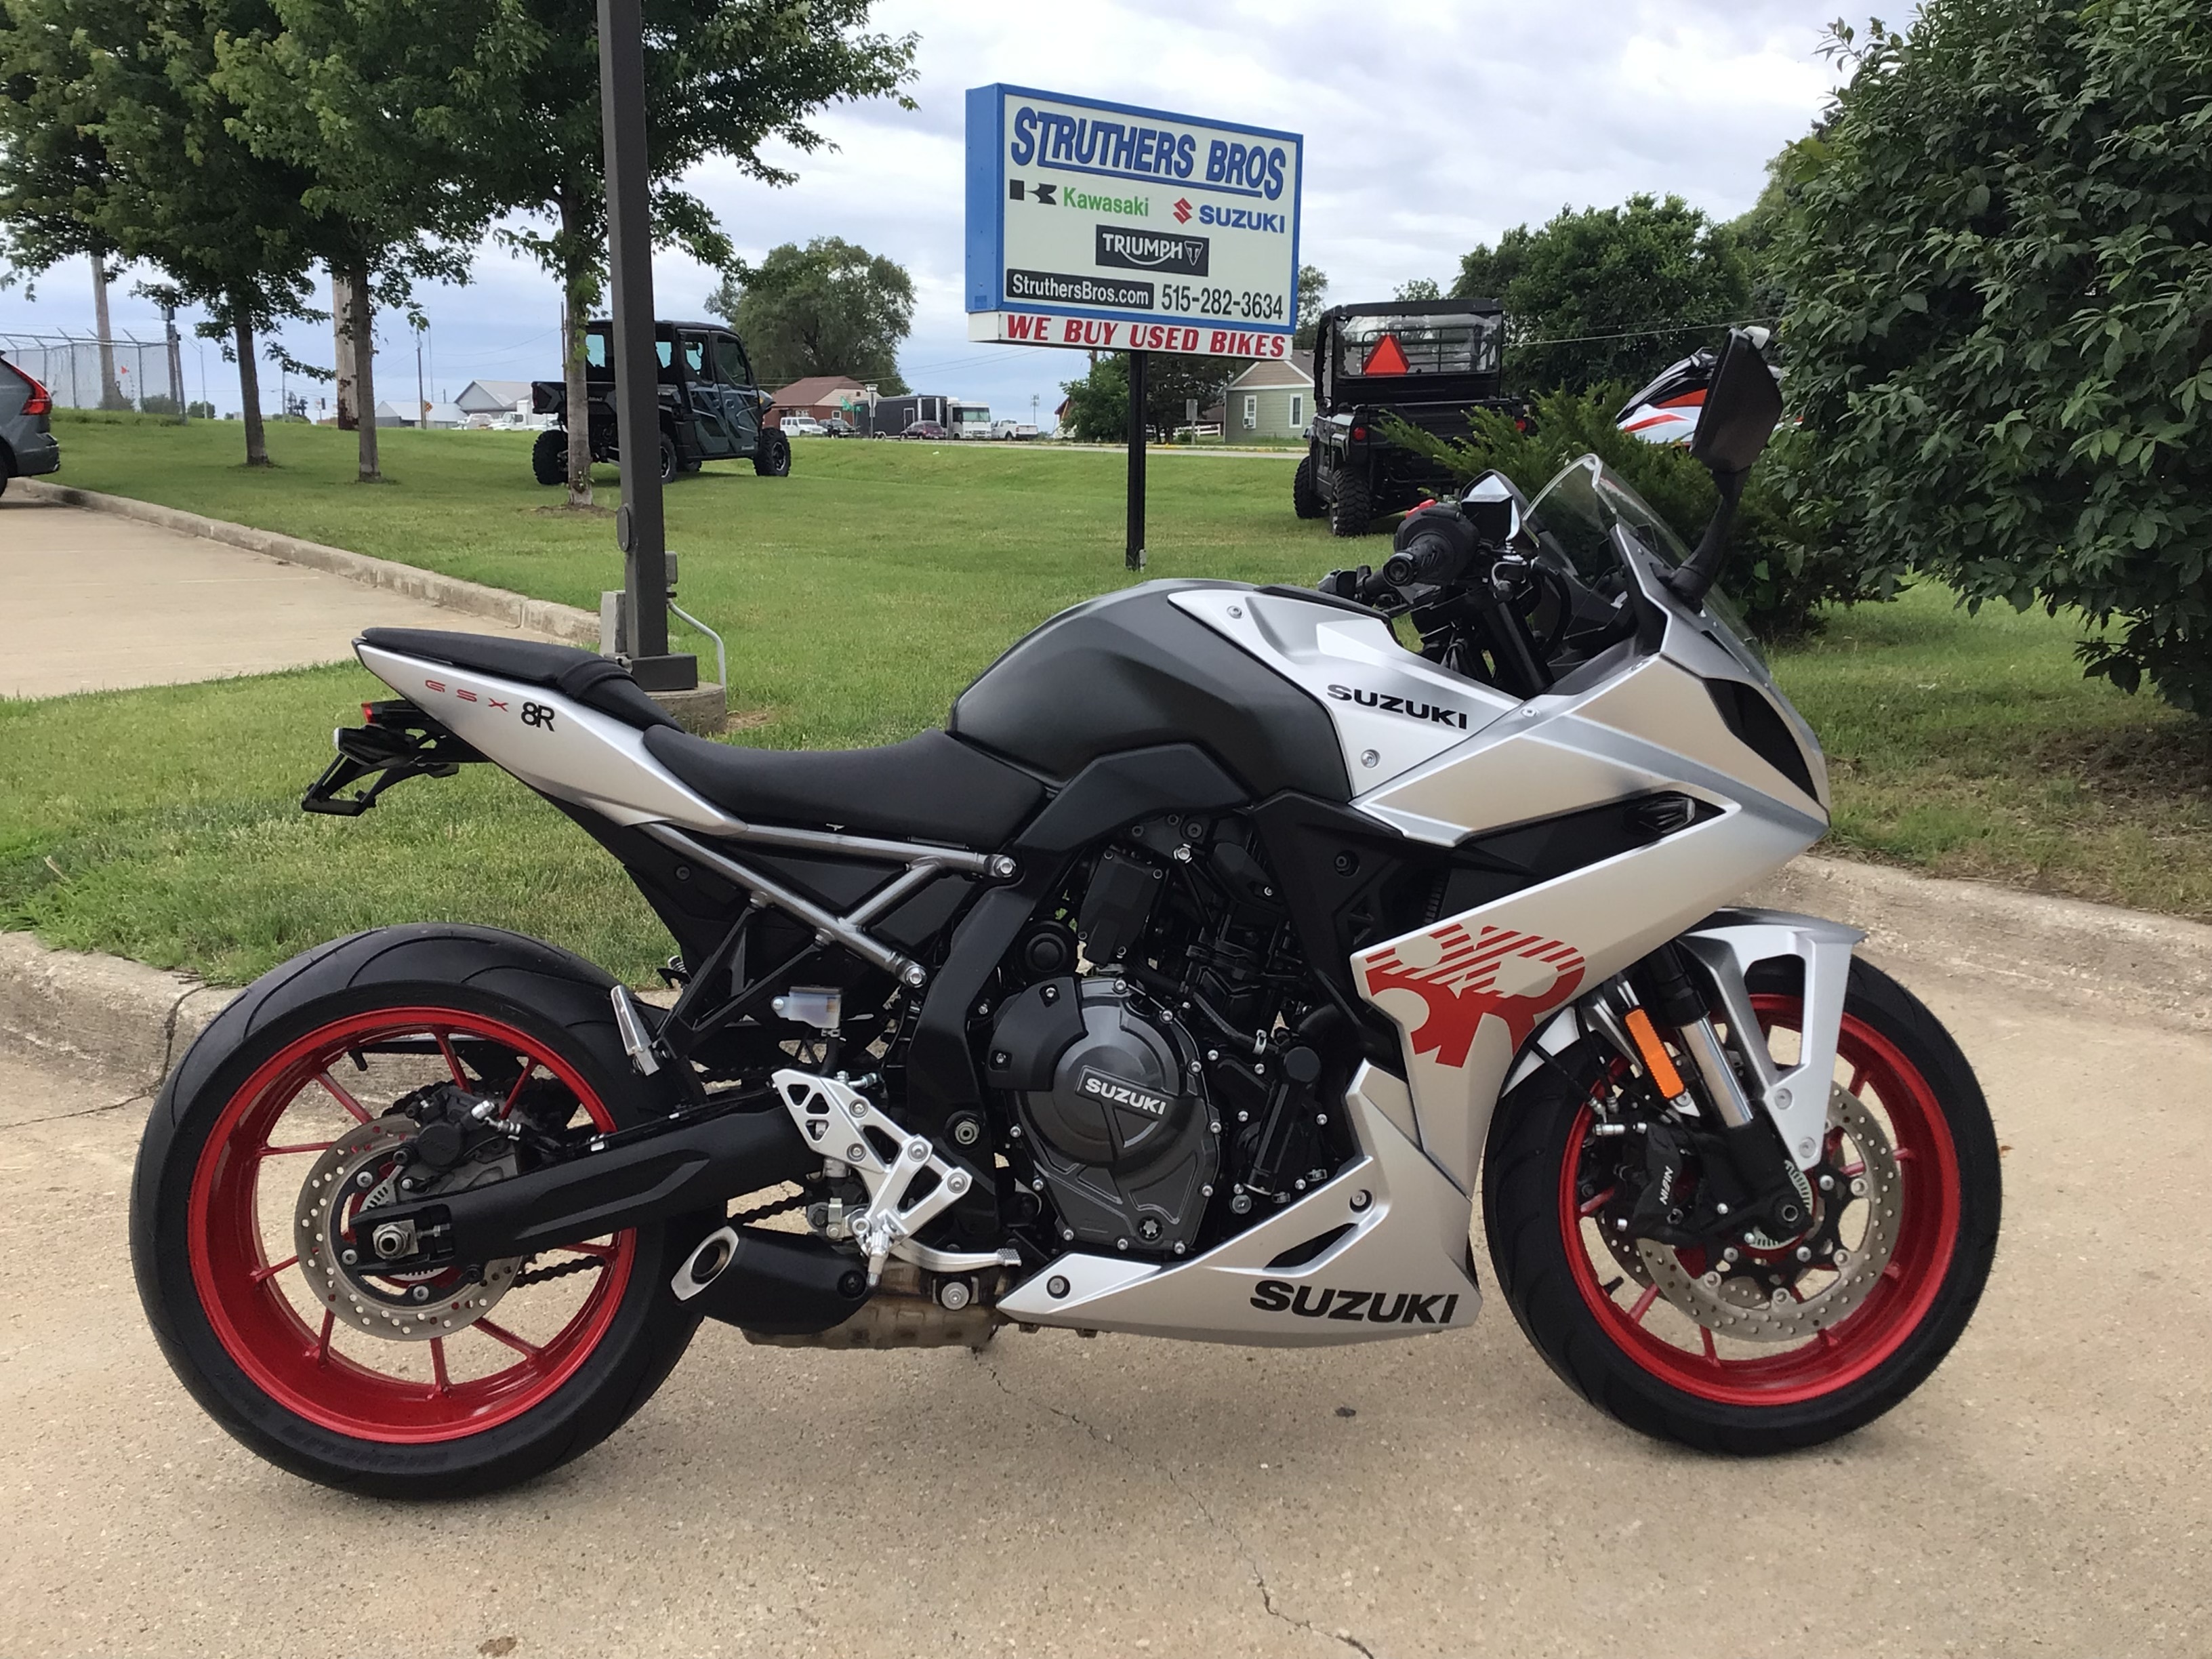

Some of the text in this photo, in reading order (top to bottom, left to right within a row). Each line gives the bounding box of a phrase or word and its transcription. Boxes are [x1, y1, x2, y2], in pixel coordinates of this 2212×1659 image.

[1010, 106, 1286, 200] STRUTHERS BROS
[1063, 187, 1149, 216] Kawasaki
[1200, 204, 1285, 233] SUZUKI
[1102, 233, 1183, 265] TRIUMPH
[1012, 274, 1149, 305] StruthersBros.com
[1162, 284, 1283, 320] 515-282-3634
[1008, 314, 1286, 357] WE BUY USED BIKES
[520, 701, 555, 732] 8R
[1327, 684, 1467, 730] SUZUKI
[1085, 1078, 1166, 1115] SUZUKI
[1250, 1279, 1459, 1324] SUZUKI
